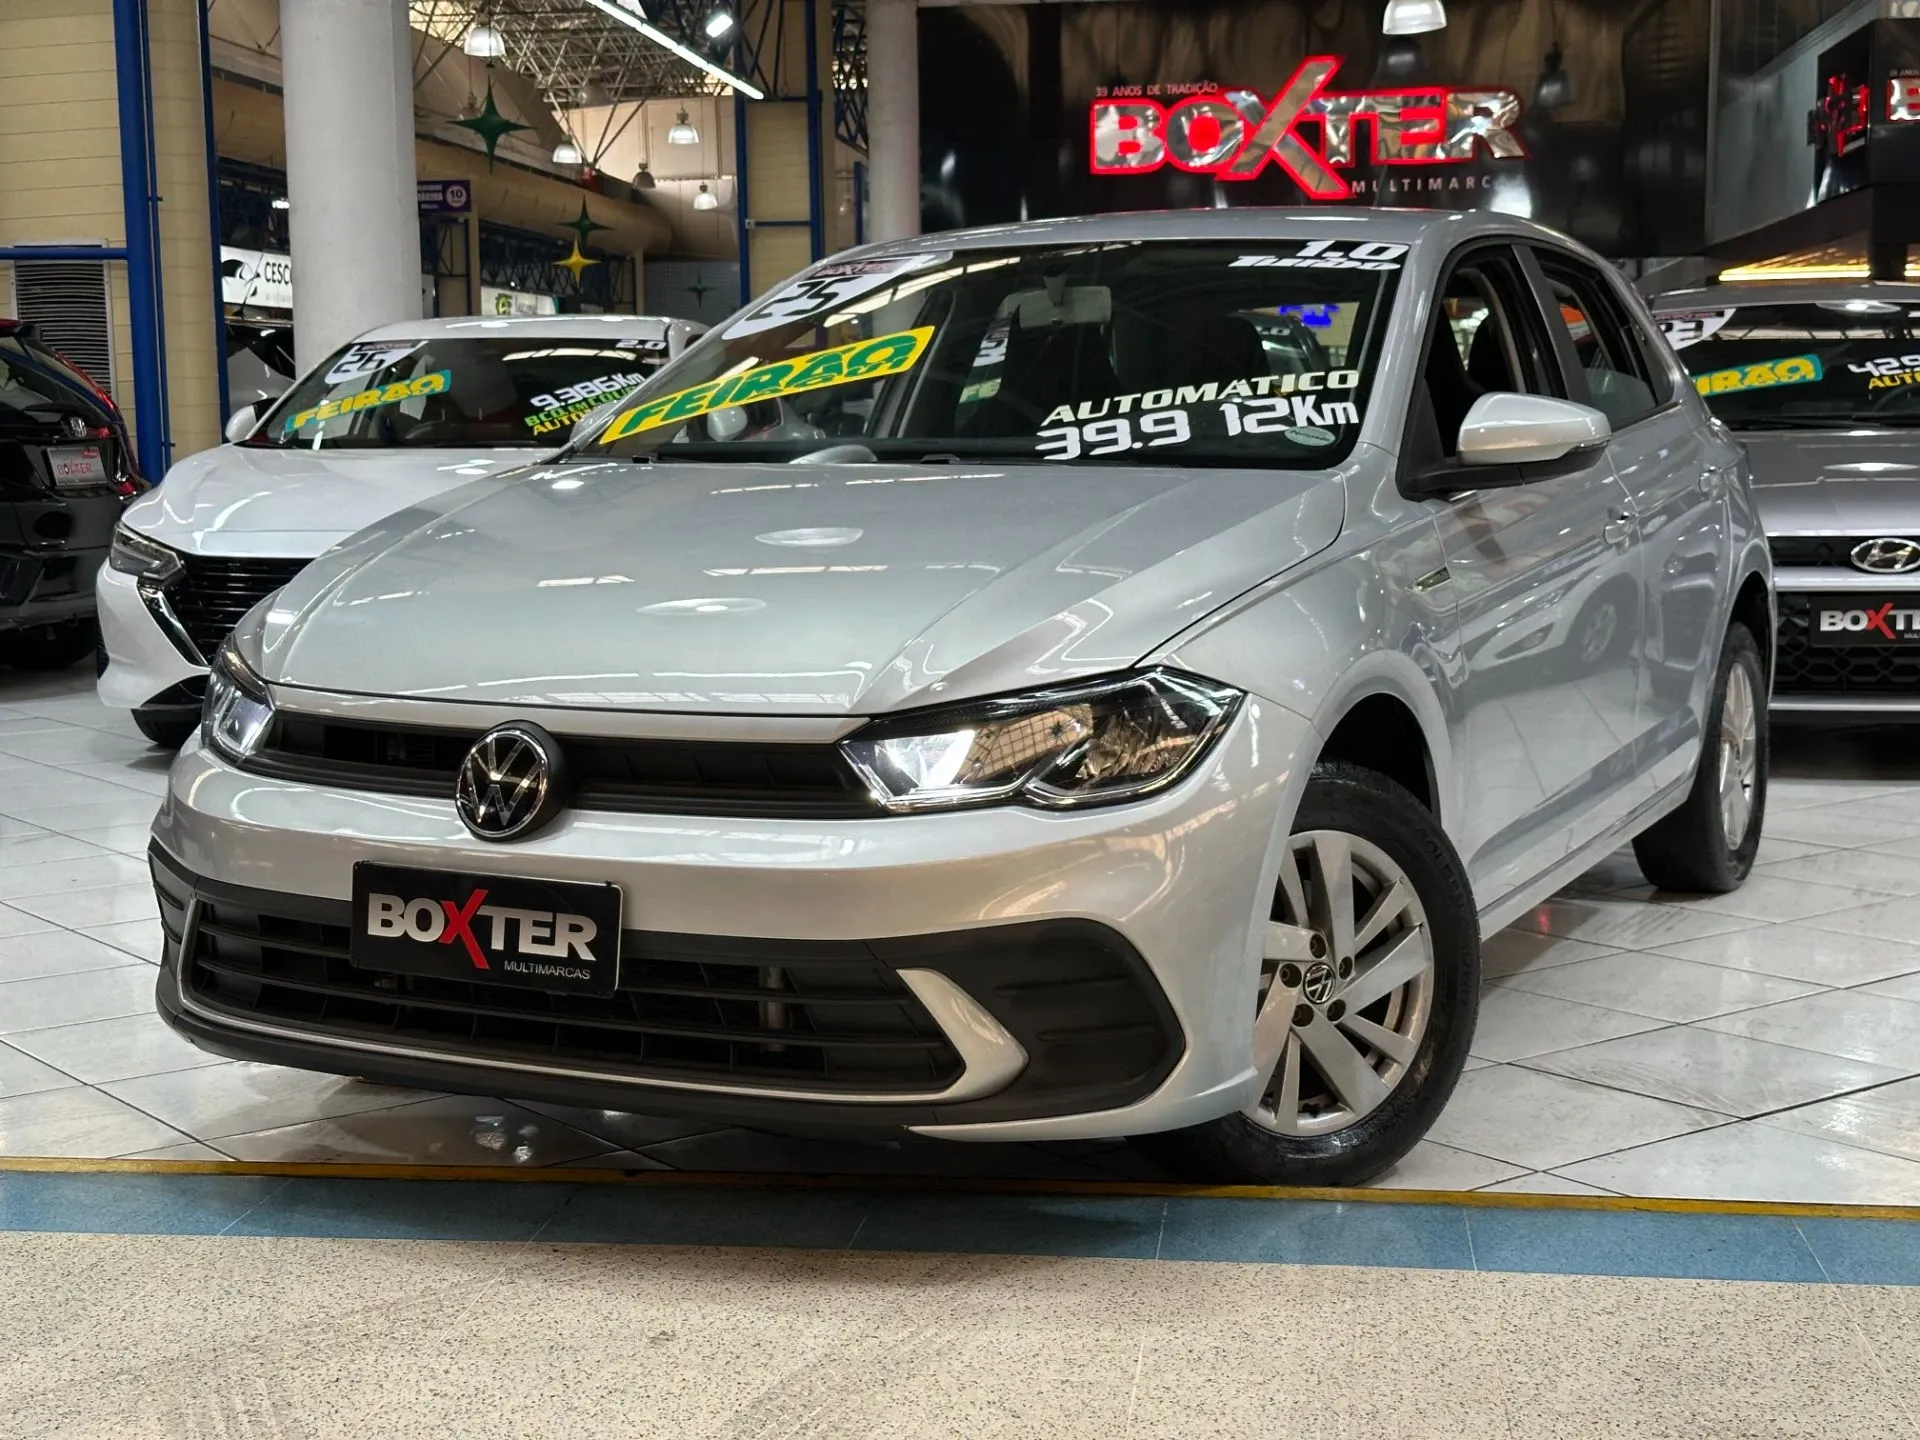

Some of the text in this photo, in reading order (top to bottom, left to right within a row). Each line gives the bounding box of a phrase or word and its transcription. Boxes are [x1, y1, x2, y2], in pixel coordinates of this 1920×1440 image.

[1112, 85, 1142, 97] ANOS
[1147, 84, 1161, 95] DE
[1166, 80, 1218, 95] TRADIÇÃO
[1090, 56, 1530, 199] BOXTER
[449, 188, 464, 201] 10
[1351, 175, 1526, 193] MULTIMARC
[1296, 240, 1411, 260] 1.0
[265, 261, 293, 285] CESC
[744, 275, 865, 322] 25
[616, 338, 667, 351] 2.0
[332, 350, 392, 374] 26
[1695, 357, 1816, 396] IRÃO
[530, 372, 647, 411] 9.386Km
[588, 385, 636, 408] COUR
[533, 408, 592, 436] AUTO
[1034, 394, 1359, 460] 39.9 12Km
[367, 888, 597, 970] BOXTER
[504, 960, 591, 979] MULTIMARCAS
